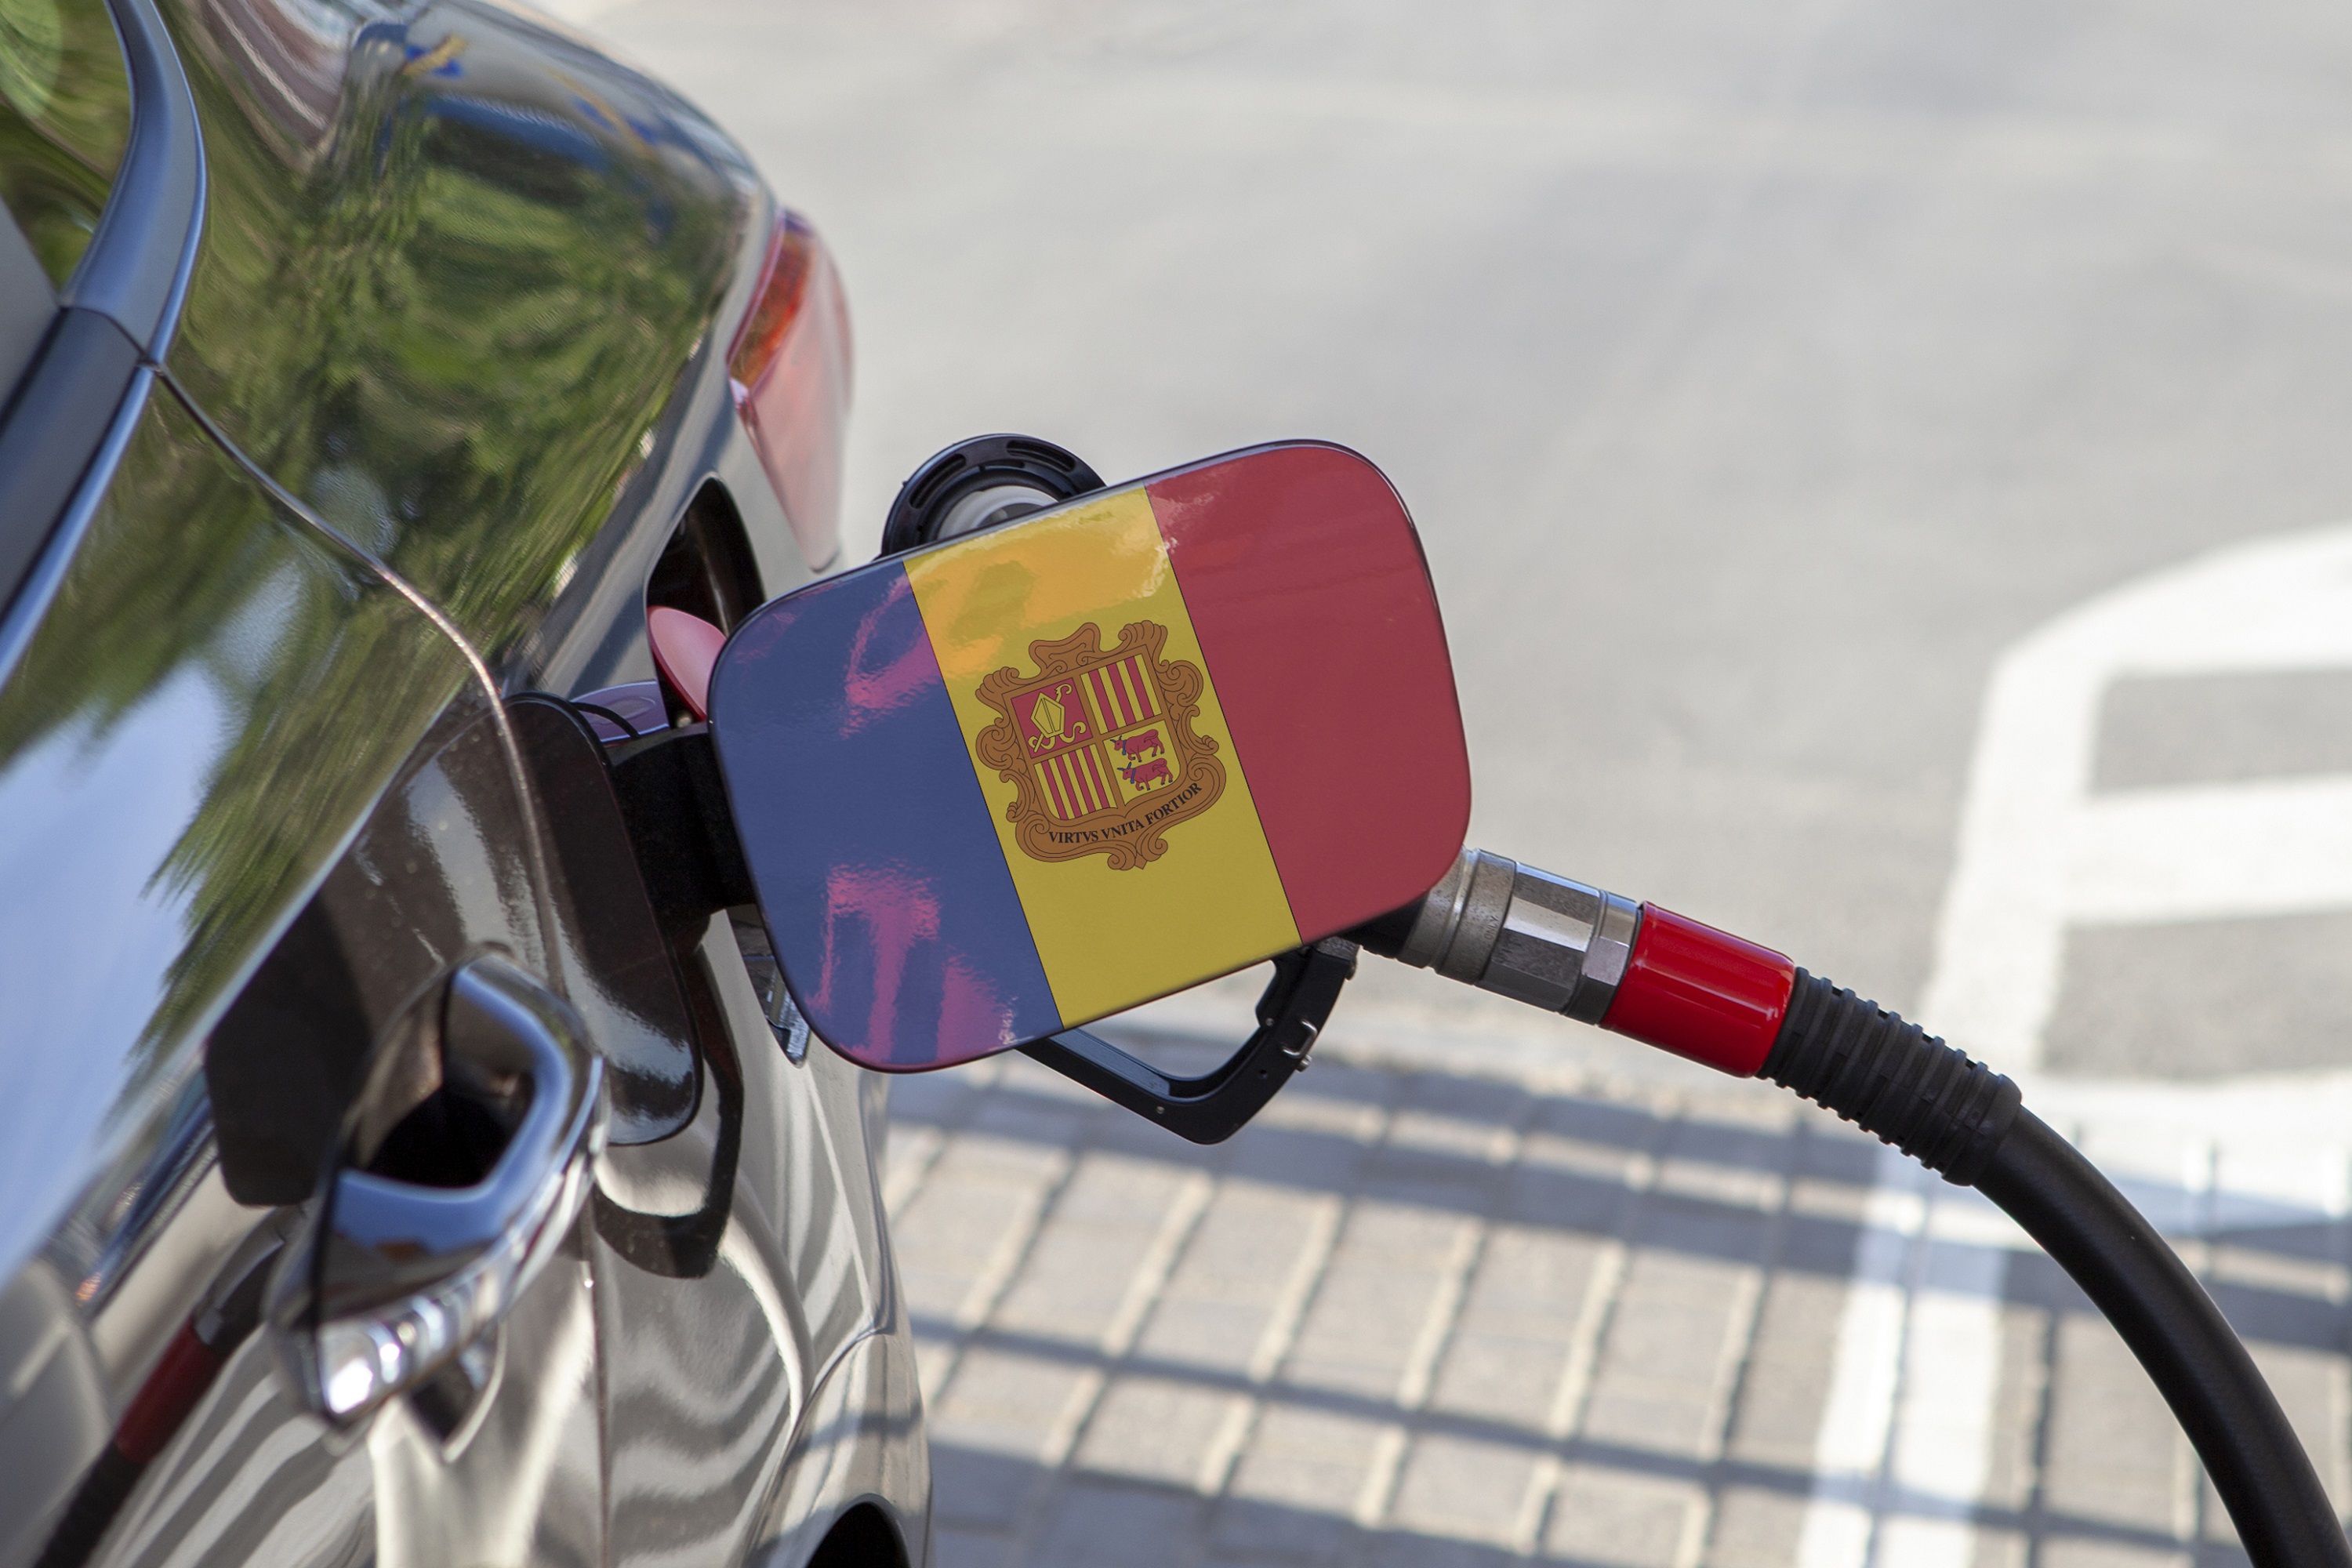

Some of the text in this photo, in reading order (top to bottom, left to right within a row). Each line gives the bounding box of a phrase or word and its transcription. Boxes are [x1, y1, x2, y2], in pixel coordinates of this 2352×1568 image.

[1048, 782, 1202, 844] VIRTVS VNITA FORTIOR
